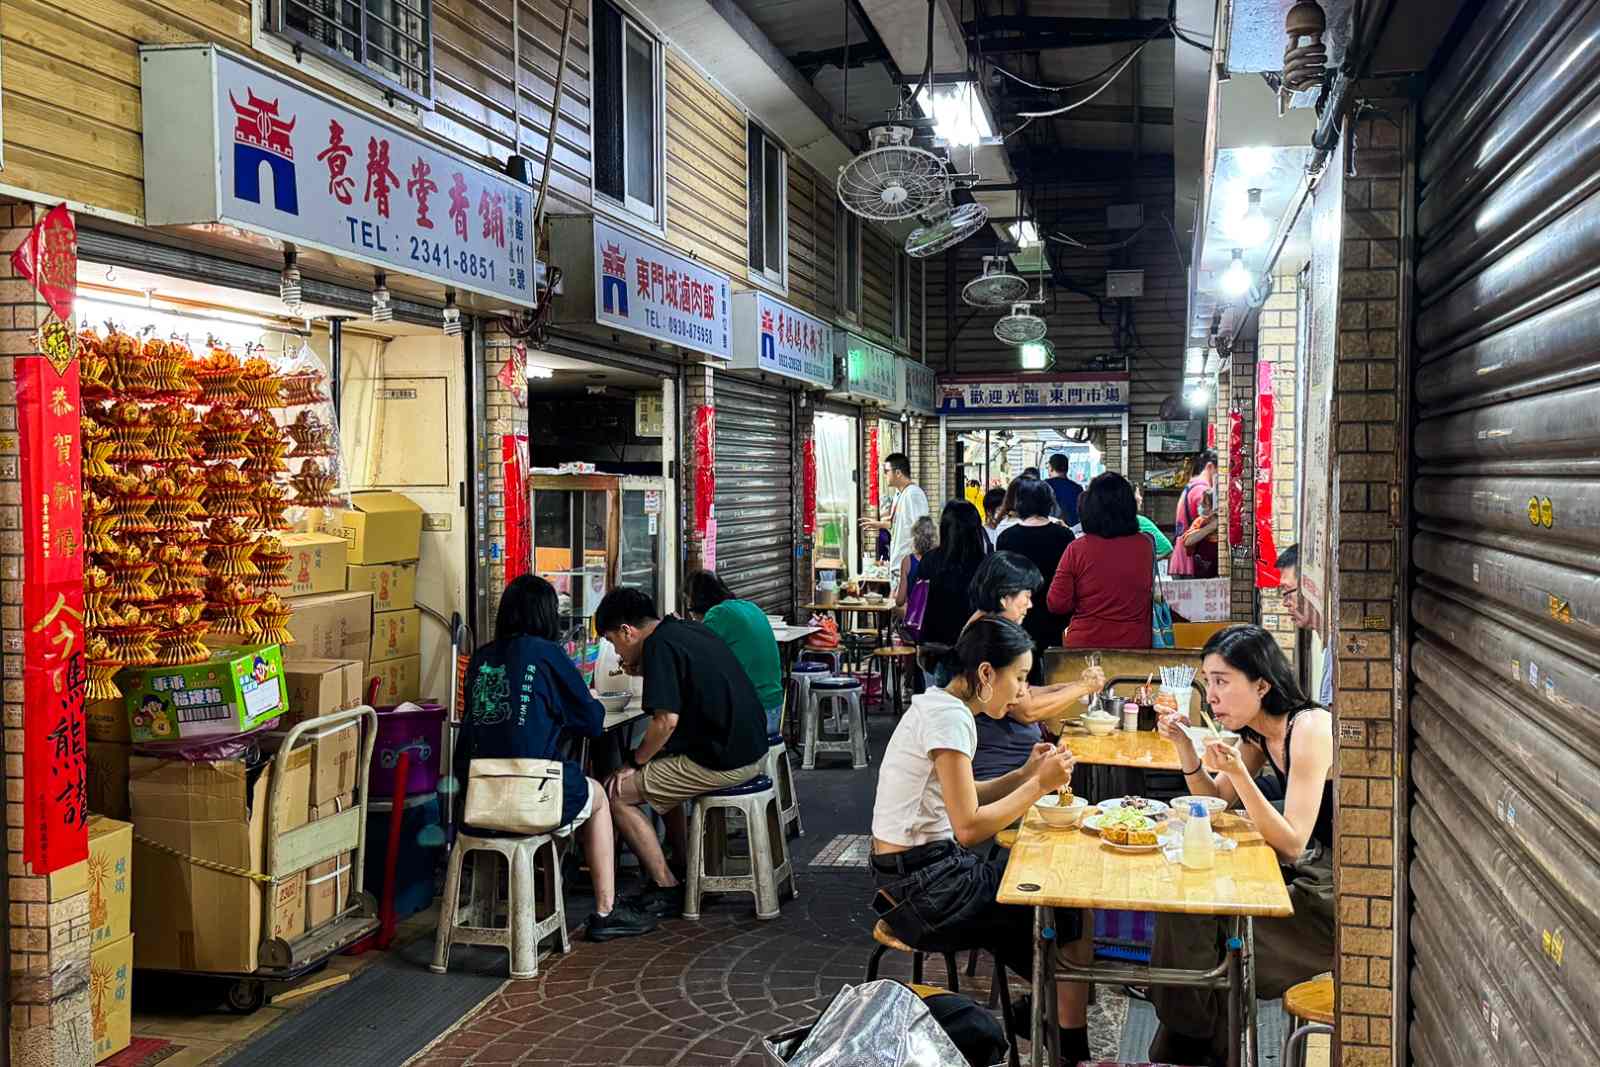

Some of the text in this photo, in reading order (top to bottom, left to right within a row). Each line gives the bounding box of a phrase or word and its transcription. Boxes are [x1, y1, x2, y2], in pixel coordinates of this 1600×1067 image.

[410, 236, 496, 282] 2341-8851
[635, 255, 715, 321] 東門城滷肉飯
[1049, 386, 1120, 404] 東門市場
[48, 386, 77, 557] 恭賀新禧
